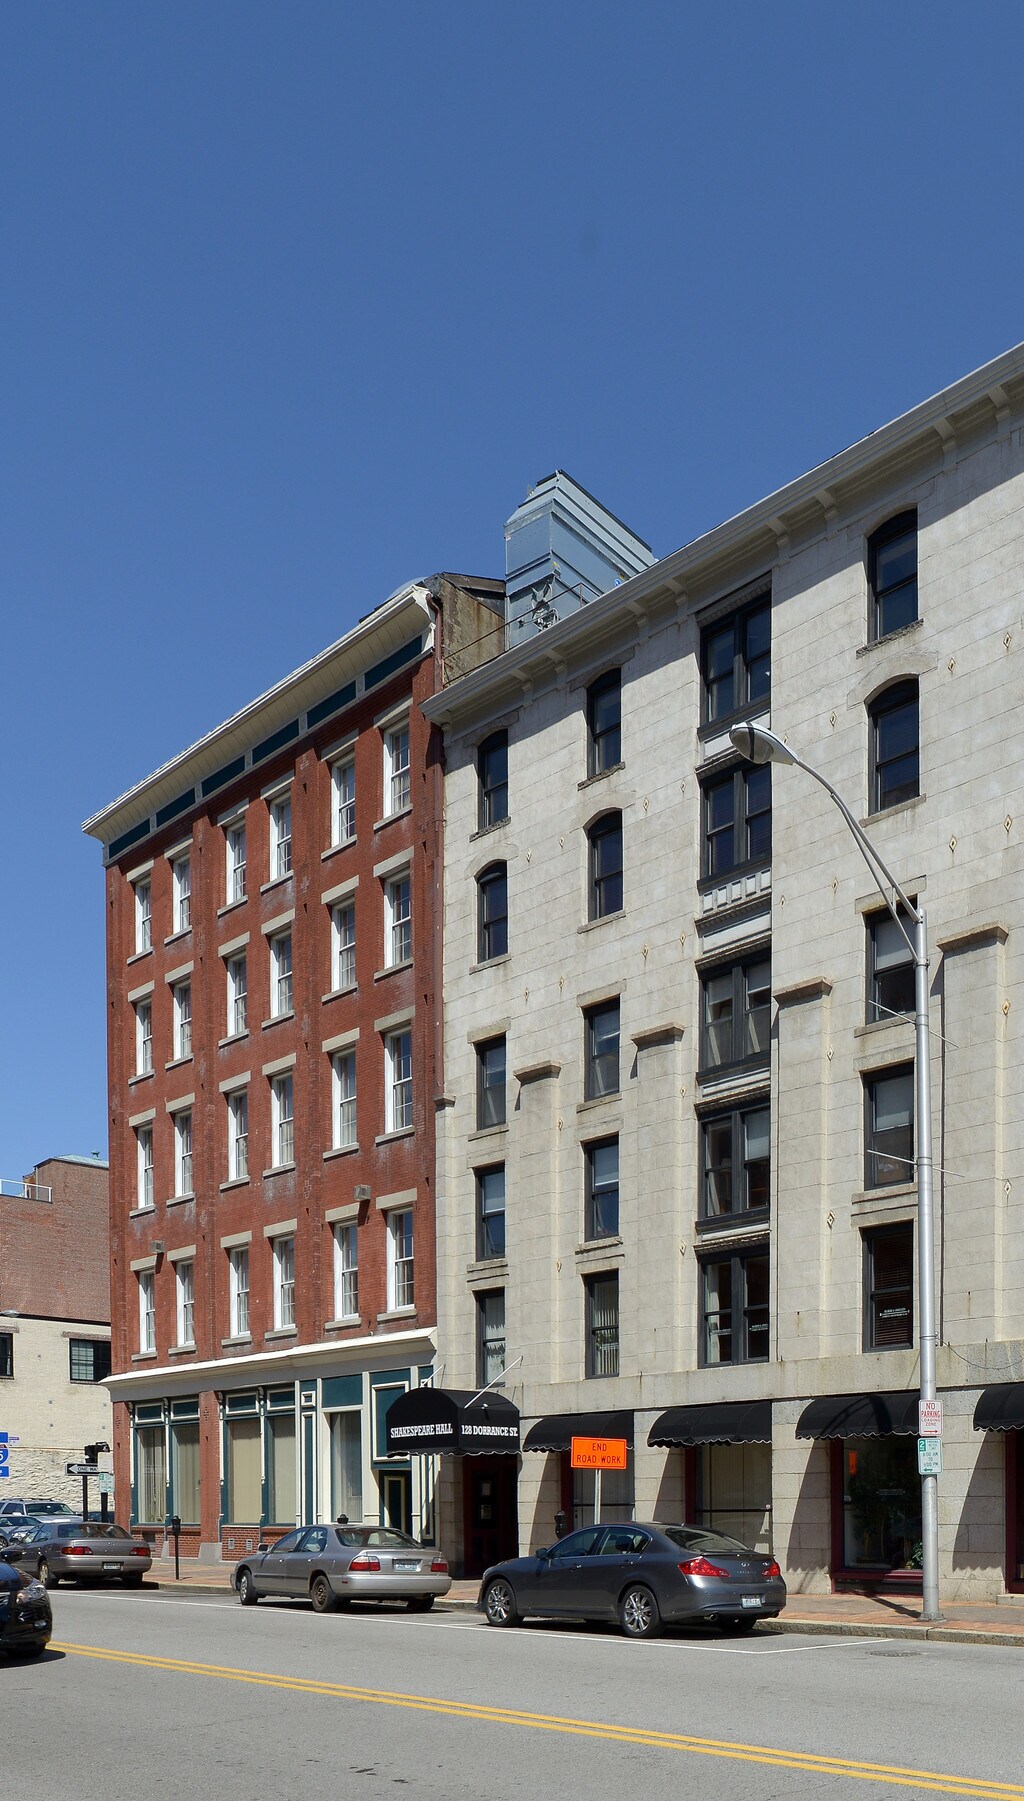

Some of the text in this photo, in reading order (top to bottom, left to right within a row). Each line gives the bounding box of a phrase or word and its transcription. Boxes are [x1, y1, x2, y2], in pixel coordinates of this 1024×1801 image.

[921, 1410, 940, 1418] PARKING
[390, 1423, 453, 1438] SHAKESPEARE HALL
[461, 1425, 472, 1435] 128
[473, 1425, 509, 1436] DORRANCE
[592, 1443, 607, 1451] END
[577, 1454, 621, 1464] ROAD WORK
